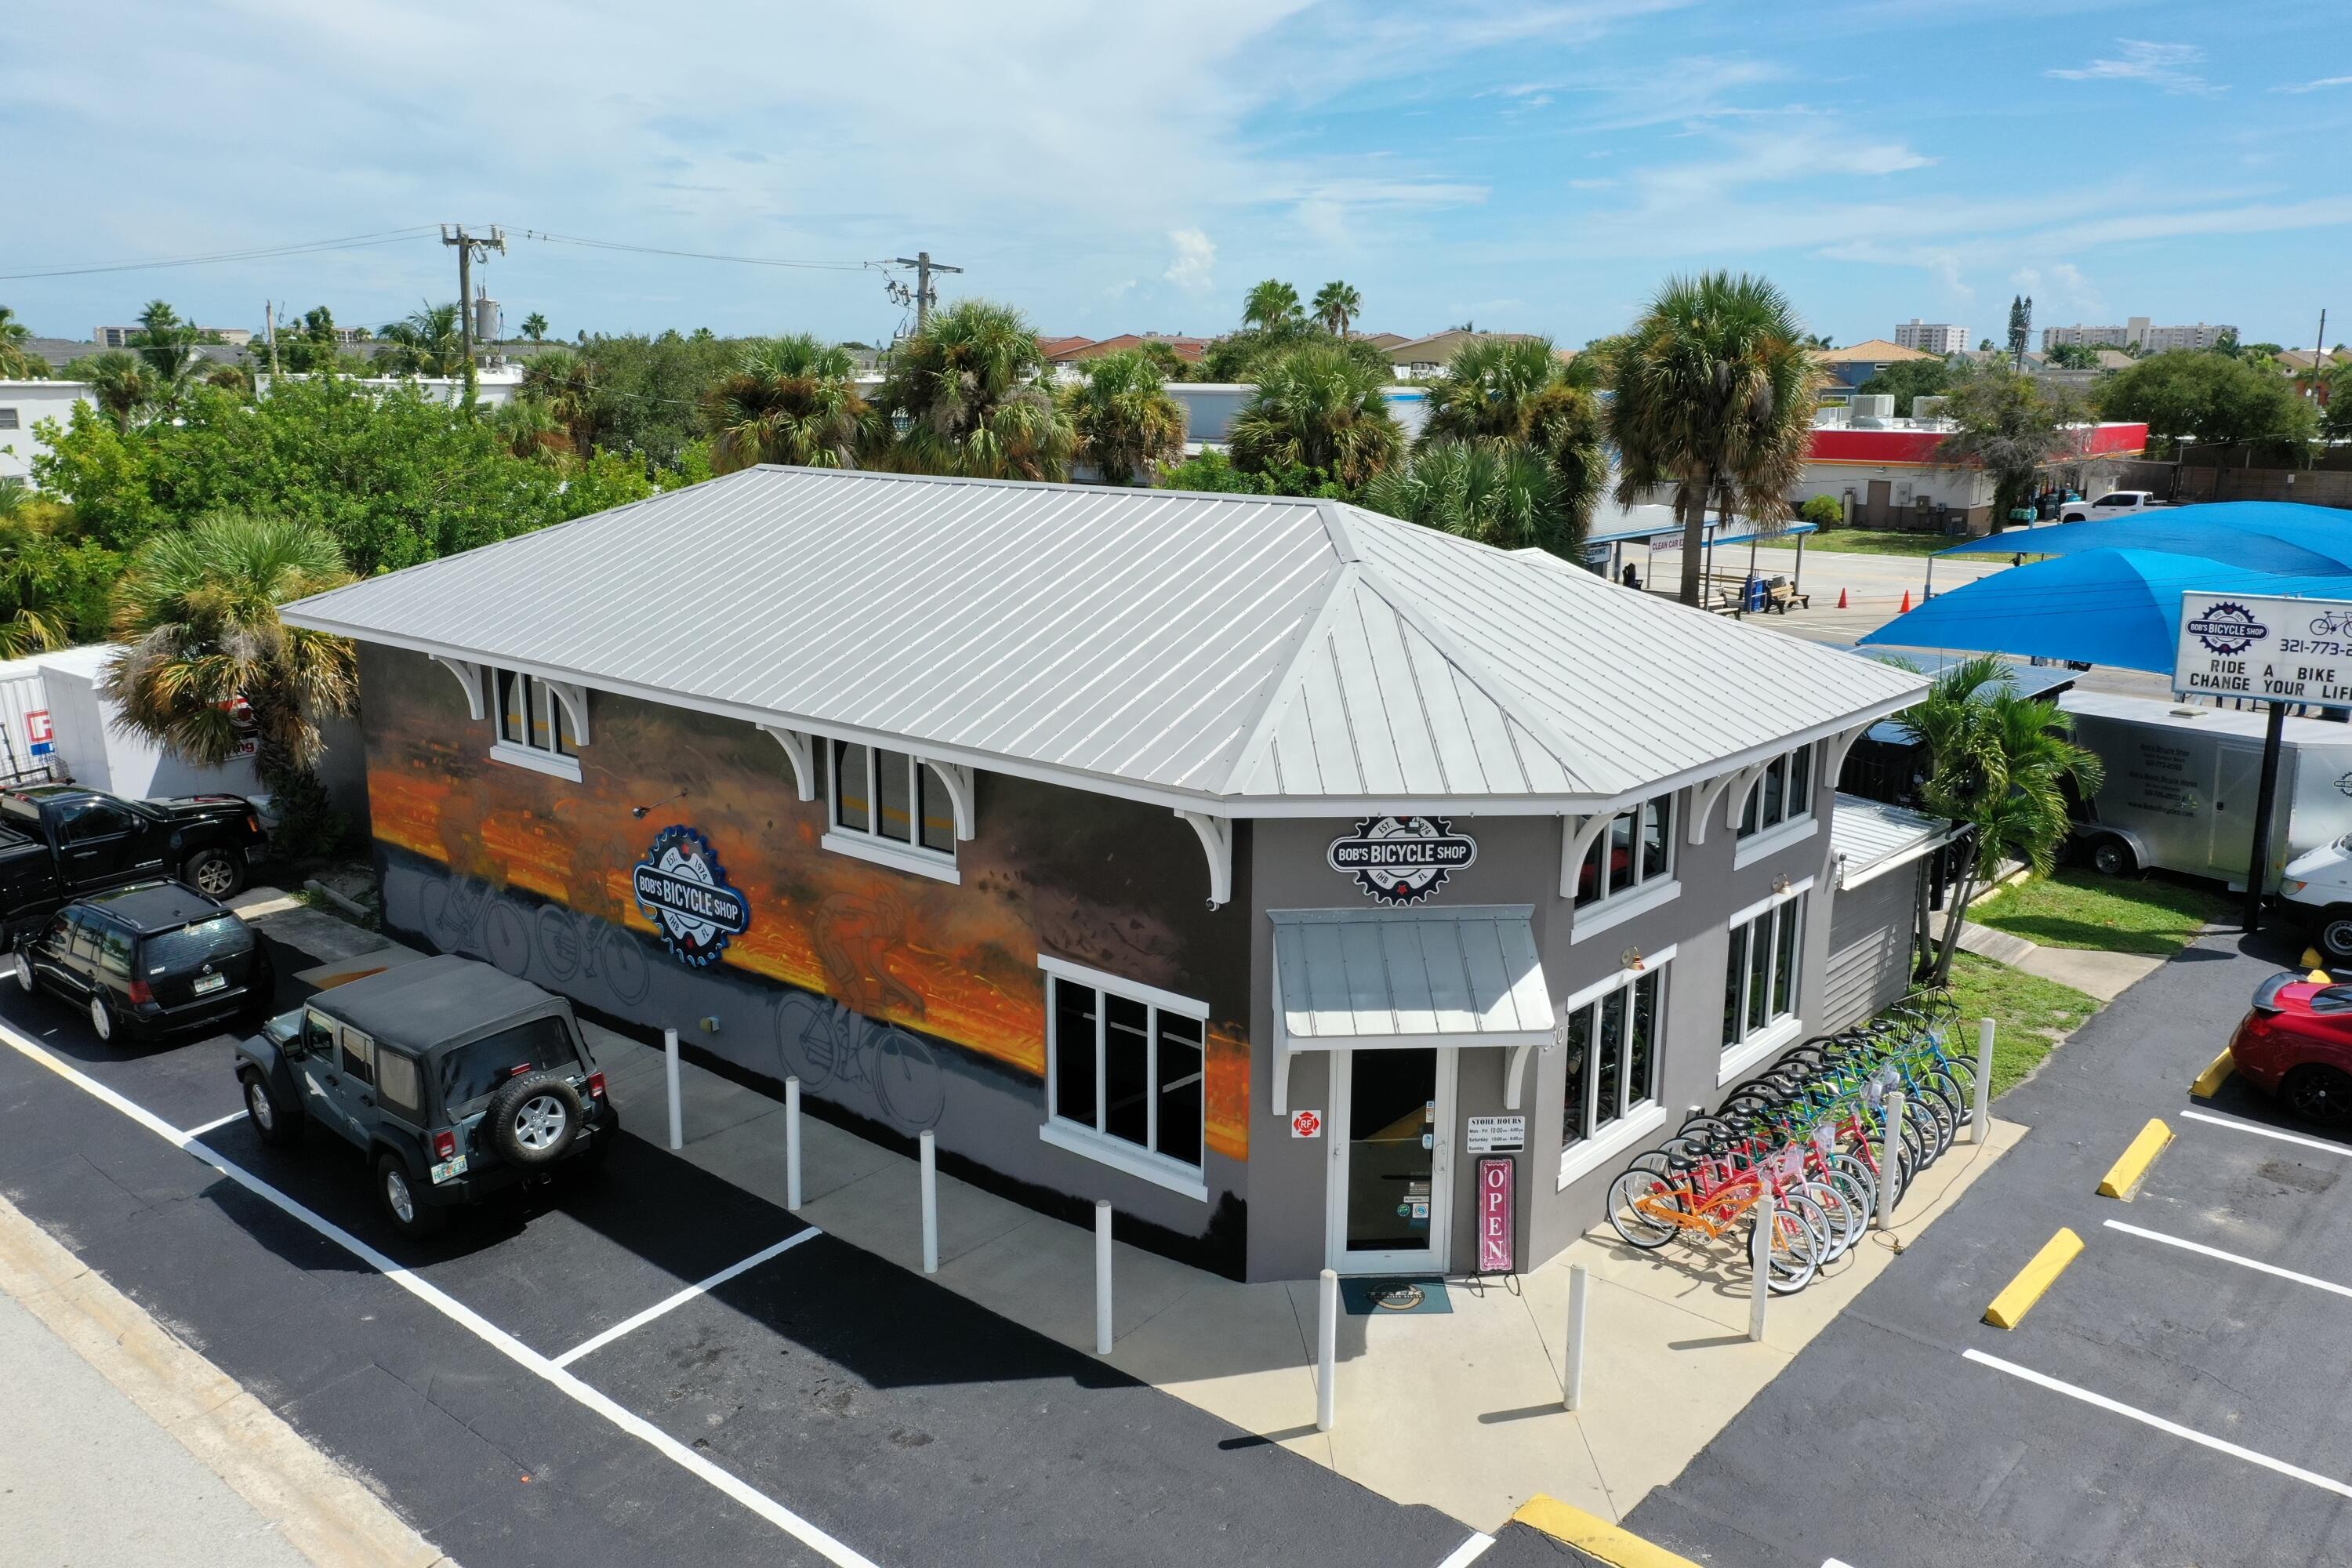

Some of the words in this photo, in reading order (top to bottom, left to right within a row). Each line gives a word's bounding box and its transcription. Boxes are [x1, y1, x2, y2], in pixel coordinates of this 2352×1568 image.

[1652, 541, 1668, 550] CLEAN
[1668, 539, 1678, 548] CAR
[2209, 623, 2245, 636] BICYCLE
[2210, 659, 2245, 674] RIDE
[2263, 664, 2274, 677] A
[2297, 667, 2336, 683] BIKE
[2190, 673, 2250, 691] CHANGE
[2264, 680, 2305, 696] YOUR
[1377, 821, 1393, 833] EST.
[1338, 848, 1369, 862] BOB'S
[1370, 844, 1434, 863] BICYCLE
[1437, 846, 1467, 859] SHOP
[666, 852, 678, 866] EST.
[695, 859, 708, 880] 1974
[1375, 872, 1388, 884] IHB
[1417, 873, 1428, 882] FL
[639, 875, 662, 897] BOB'S
[663, 880, 713, 916] BICYCLE
[714, 899, 739, 920] SHOP
[669, 916, 680, 932] IHB
[701, 928, 710, 938] FL
[1301, 1120, 1312, 1129] RF
[1487, 1169, 1504, 1260] OPEN
